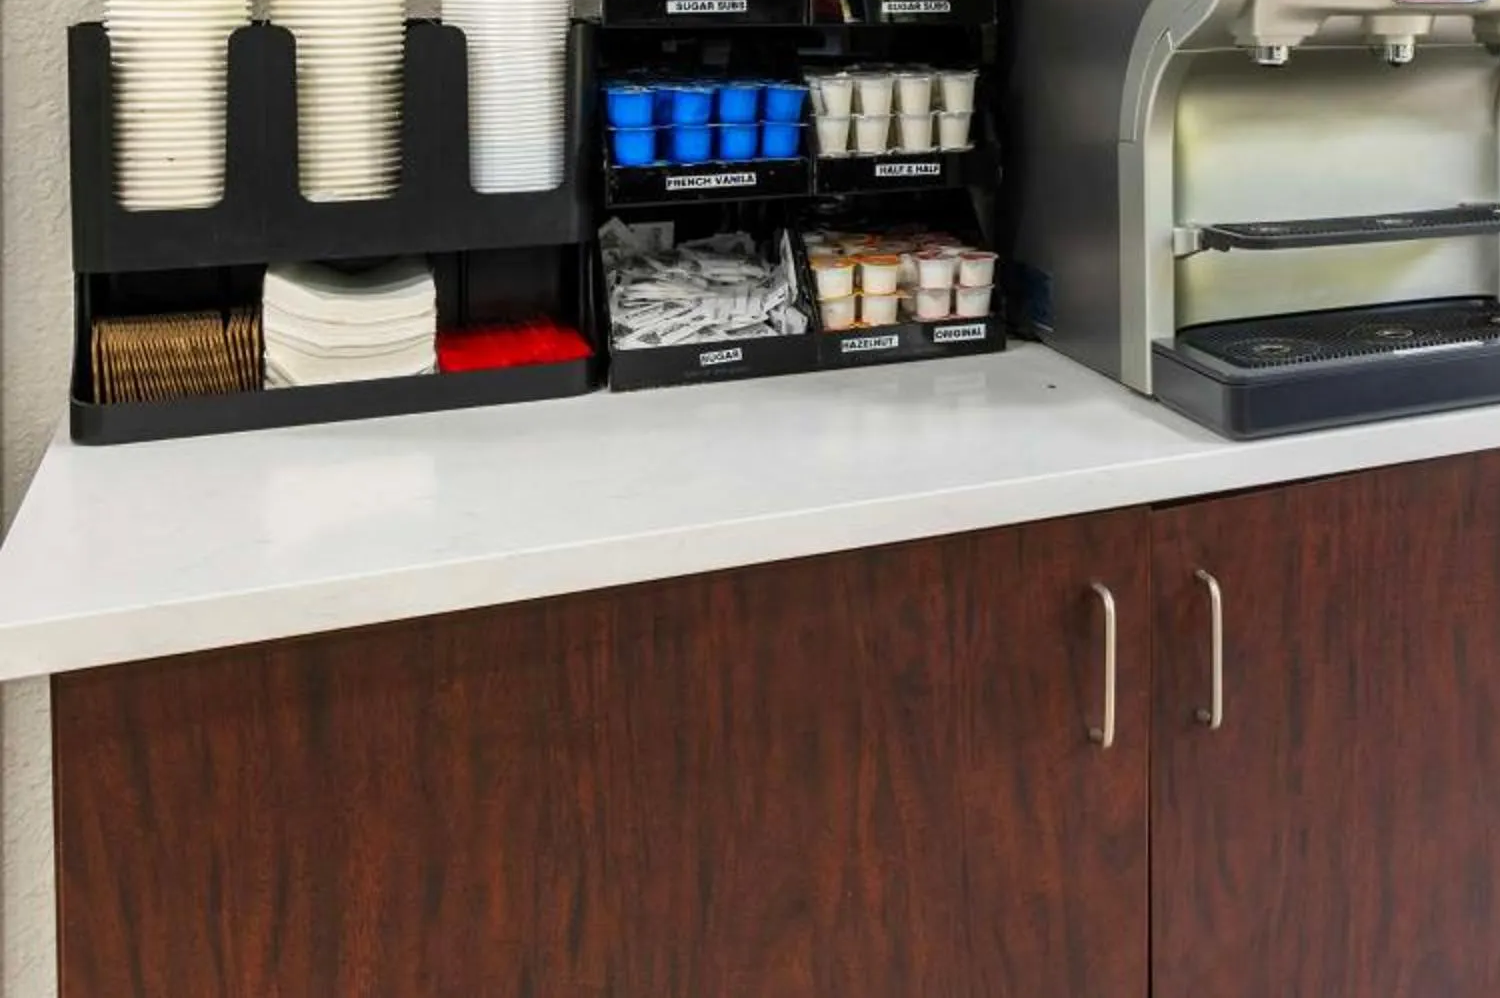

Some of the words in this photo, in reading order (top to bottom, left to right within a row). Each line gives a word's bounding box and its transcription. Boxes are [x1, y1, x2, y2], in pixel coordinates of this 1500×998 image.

[675, 1, 715, 12] SUGAR
[887, 2, 921, 12] SUGAR
[923, 2, 949, 11] SUBS
[879, 165, 905, 175] HALF
[914, 164, 940, 174] HALF
[666, 176, 713, 188] FRENCH
[936, 327, 982, 341] ORIGINAL
[842, 337, 894, 352] HAZELNUT
